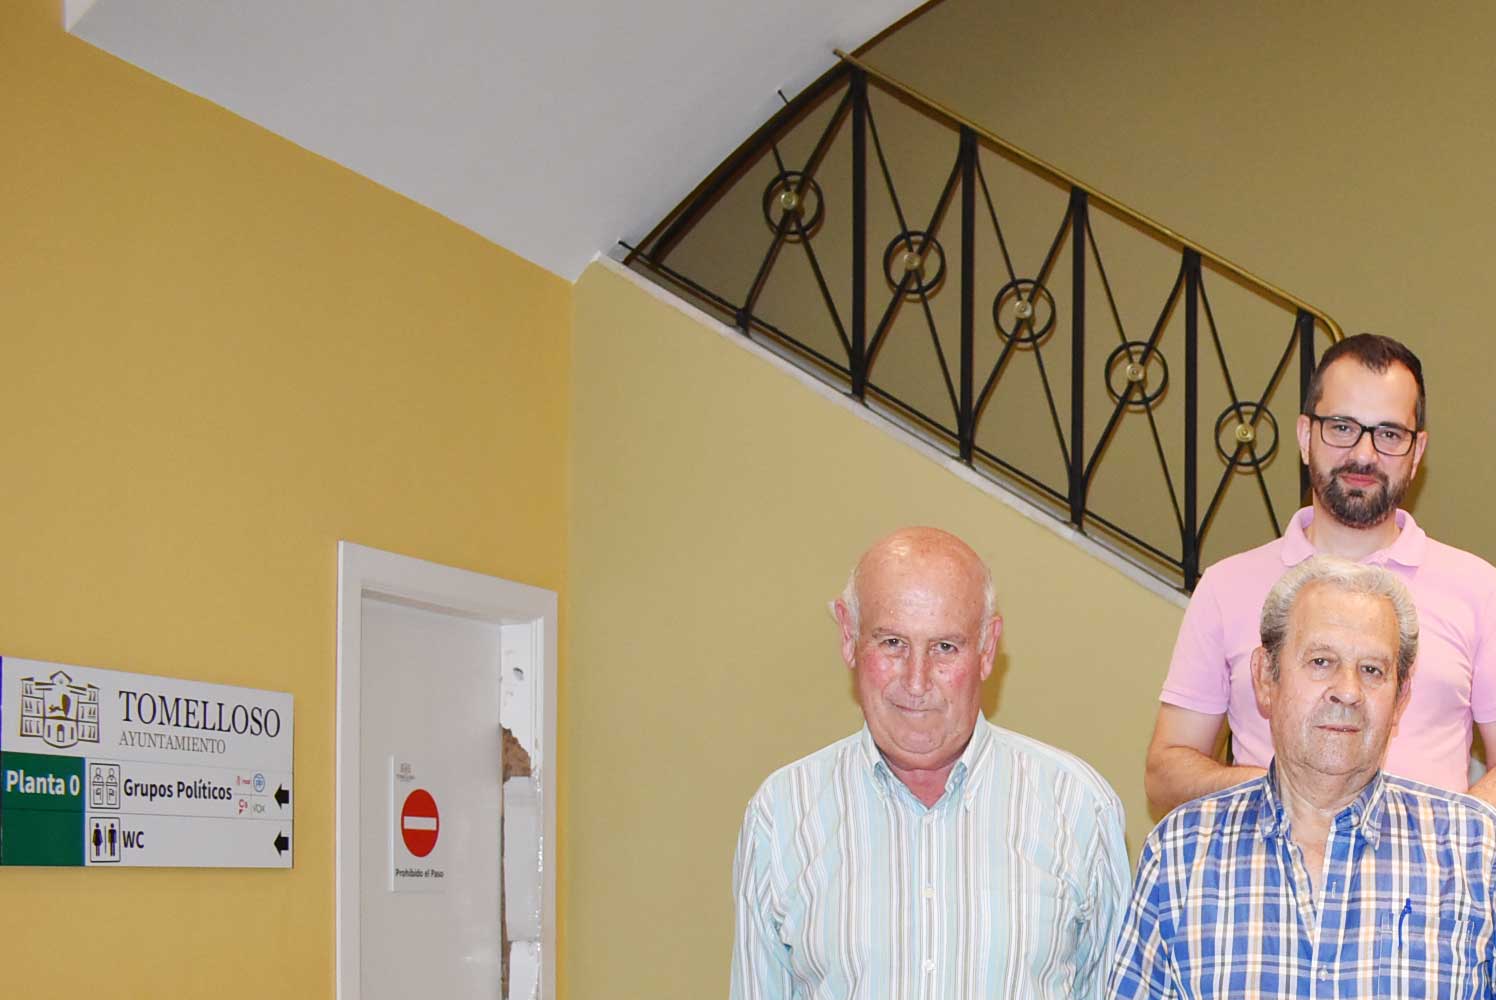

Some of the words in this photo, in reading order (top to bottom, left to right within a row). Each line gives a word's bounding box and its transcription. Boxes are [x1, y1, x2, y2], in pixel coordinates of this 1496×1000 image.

[118, 690, 281, 738] TOMELLOSO
[118, 730, 226, 754] AYUNTAMIENTO
[6, 770, 66, 796] Planta
[70, 778, 80, 796] 0
[124, 778, 174, 802] Grupos
[177, 779, 232, 801] Políticos
[123, 830, 144, 848] WC
[395, 868, 423, 878] Prohibido
[425, 869, 430, 877] el
[431, 870, 444, 878] Paso
